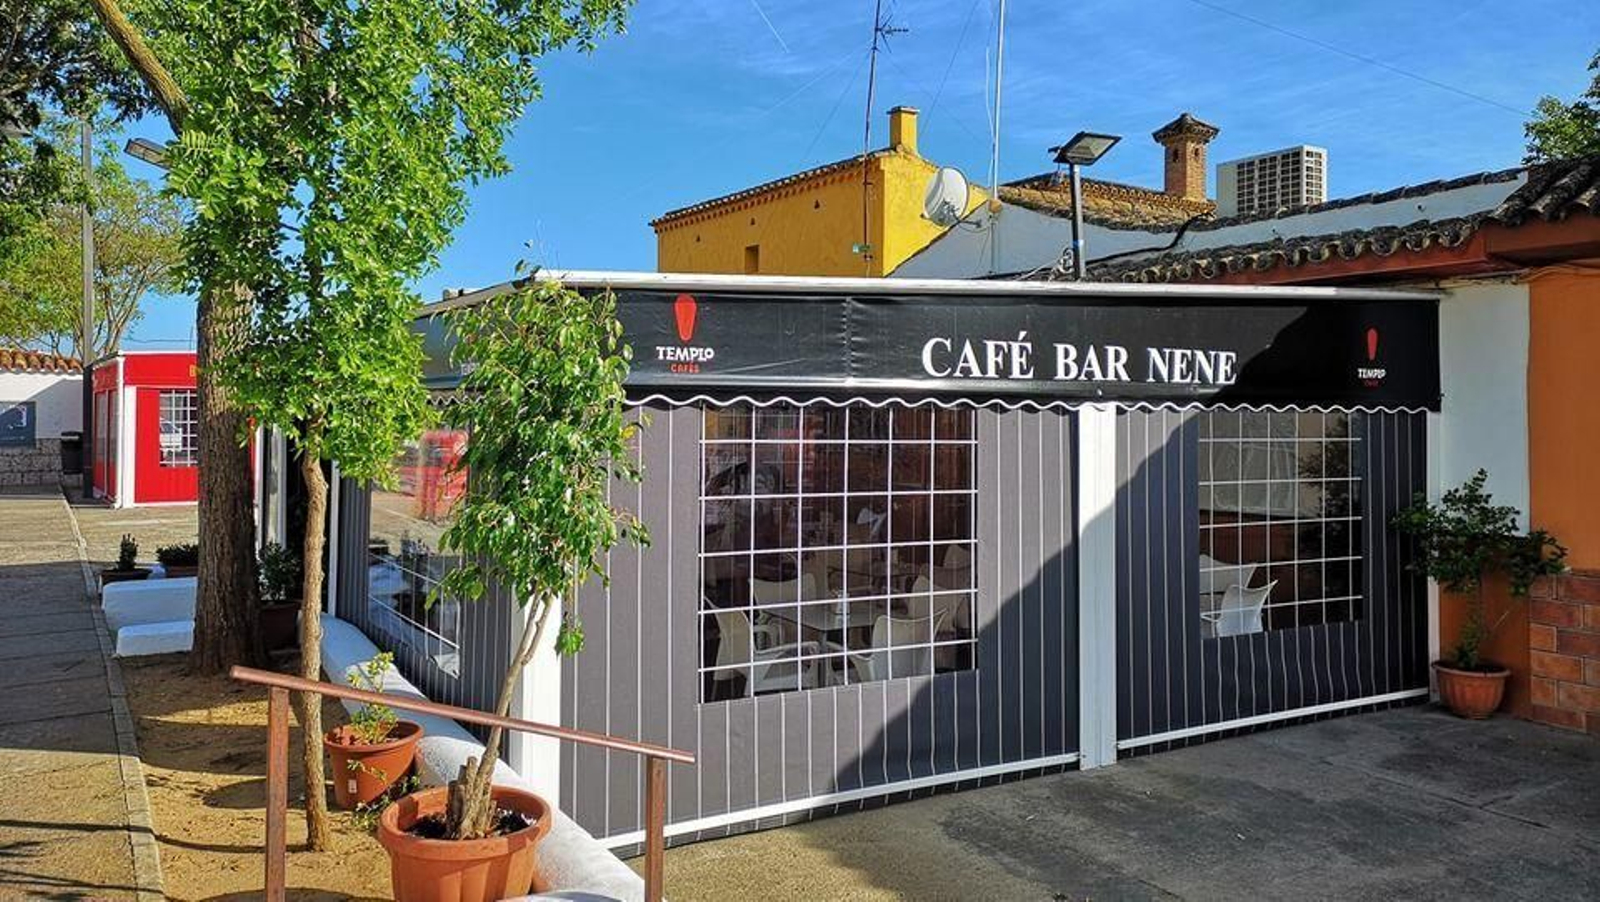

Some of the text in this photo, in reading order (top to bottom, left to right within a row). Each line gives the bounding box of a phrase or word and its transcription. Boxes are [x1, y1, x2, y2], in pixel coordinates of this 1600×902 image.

[655, 346, 715, 361] TEMPLO
[921, 331, 1237, 385] CAFÉ BAR NENE
